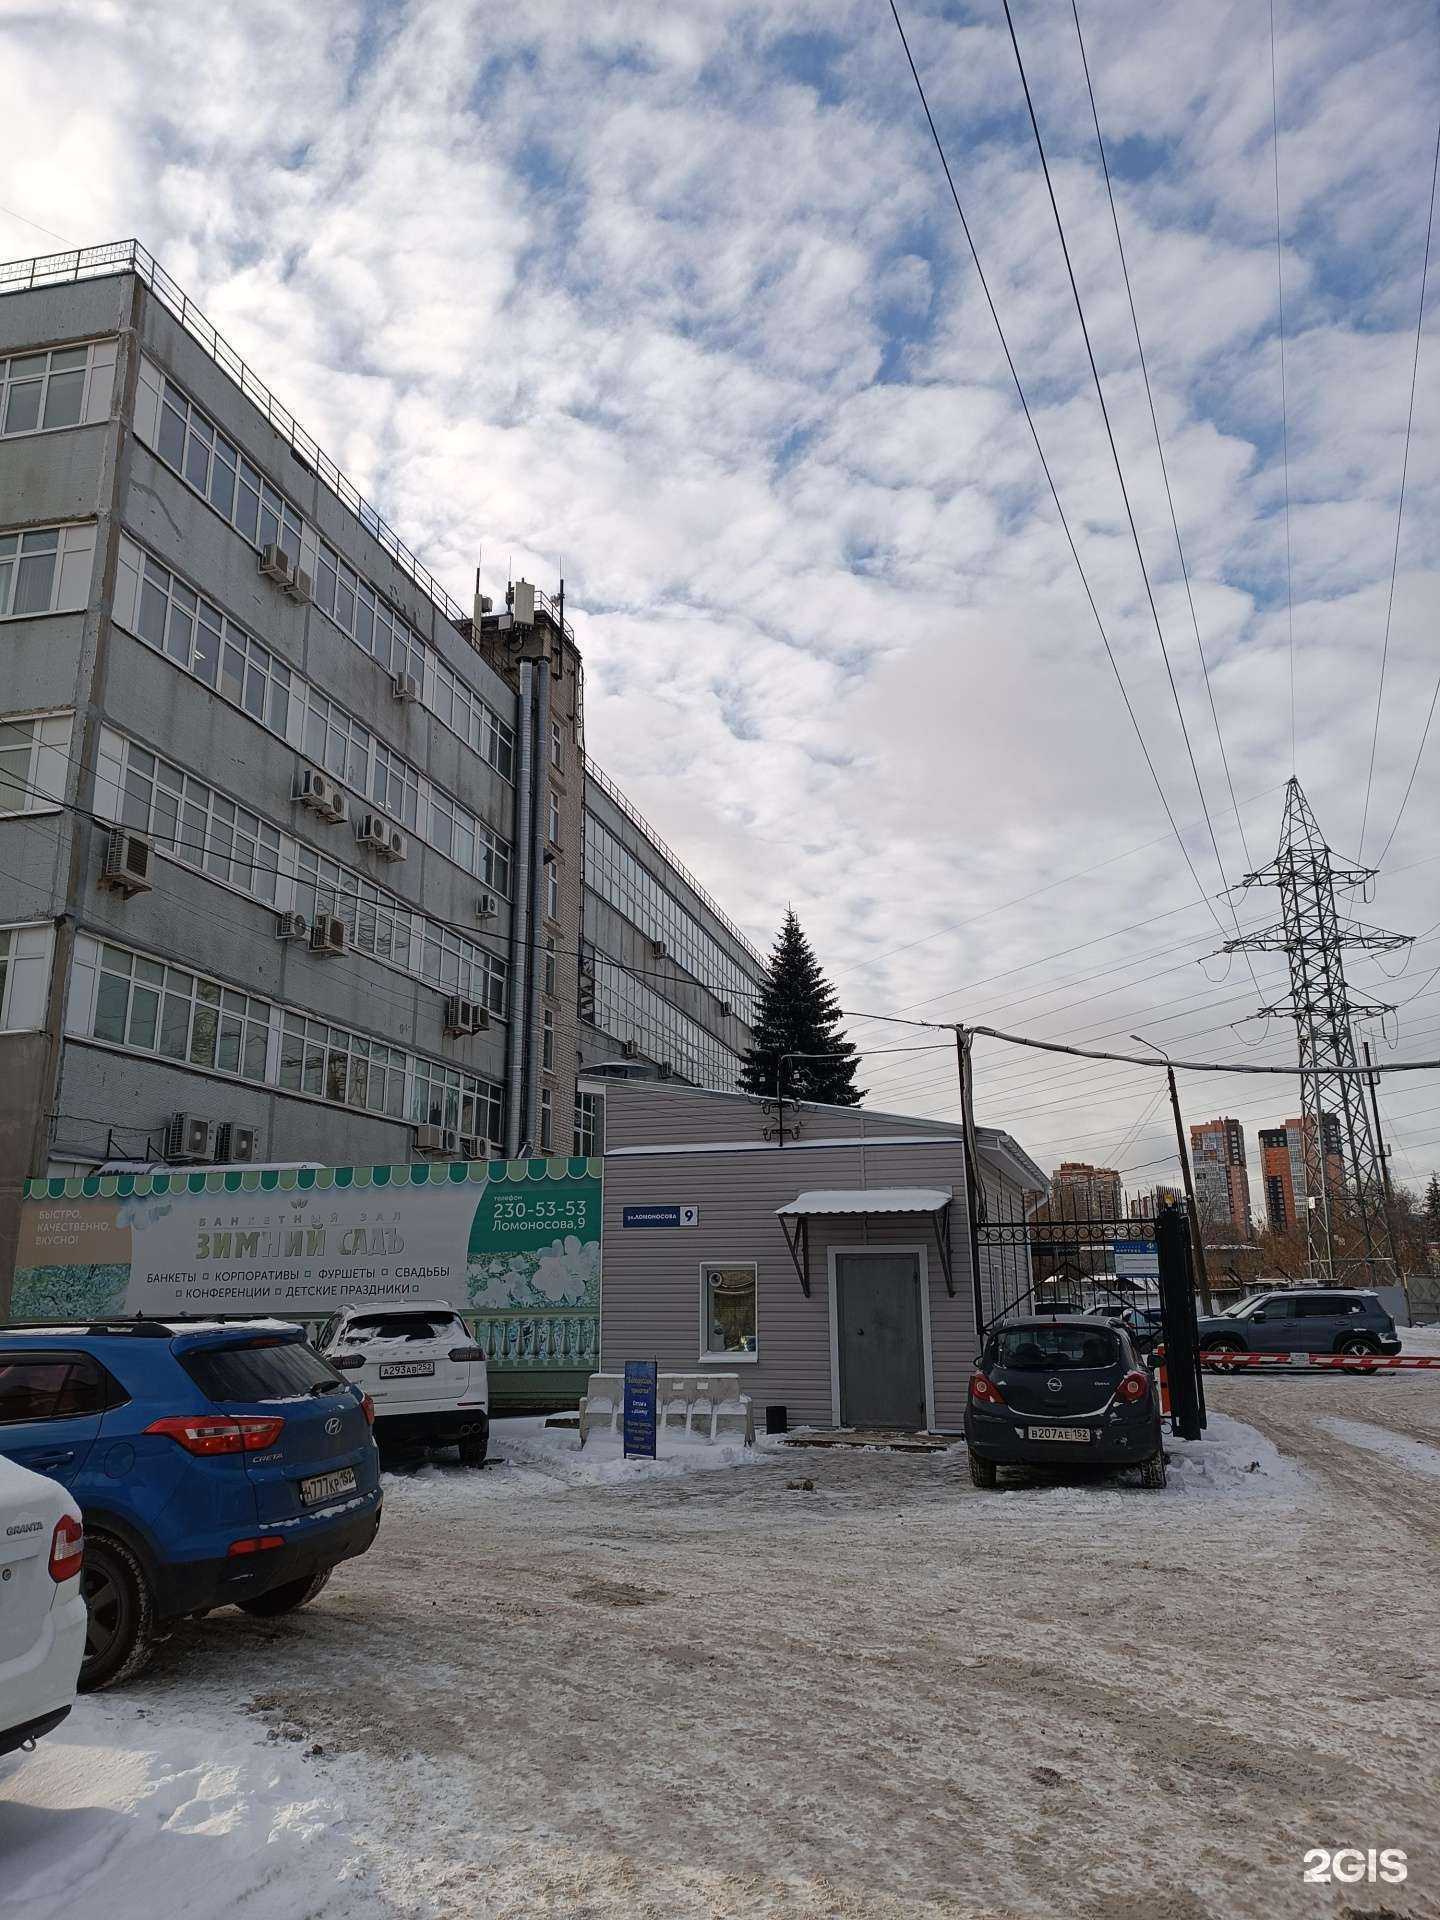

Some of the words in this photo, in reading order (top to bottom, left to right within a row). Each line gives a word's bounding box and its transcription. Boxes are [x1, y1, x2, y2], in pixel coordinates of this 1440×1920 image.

[493, 1200, 587, 1219] 230-53-53
[684, 1209, 694, 1222] 9
[37, 1221, 112, 1234] КАЧЕСТВЕННО,
[35, 1234, 80, 1247] ВКУСНО!
[195, 1221, 327, 1260] ЗИМНИЙ
[146, 1272, 197, 1284] БАНКЕТЫ
[214, 1269, 300, 1283] КОРПОРАТИВЫ
[318, 1268, 376, 1280] ФУРШЕТЫ
[395, 1266, 450, 1278] СВАДЬБЫ
[186, 1287, 271, 1300] КОНФЕРЕНЦИИ
[285, 1285, 338, 1299] ДЕТСКИЕ
[340, 1283, 410, 1297] ПРАЗДНИКИ
